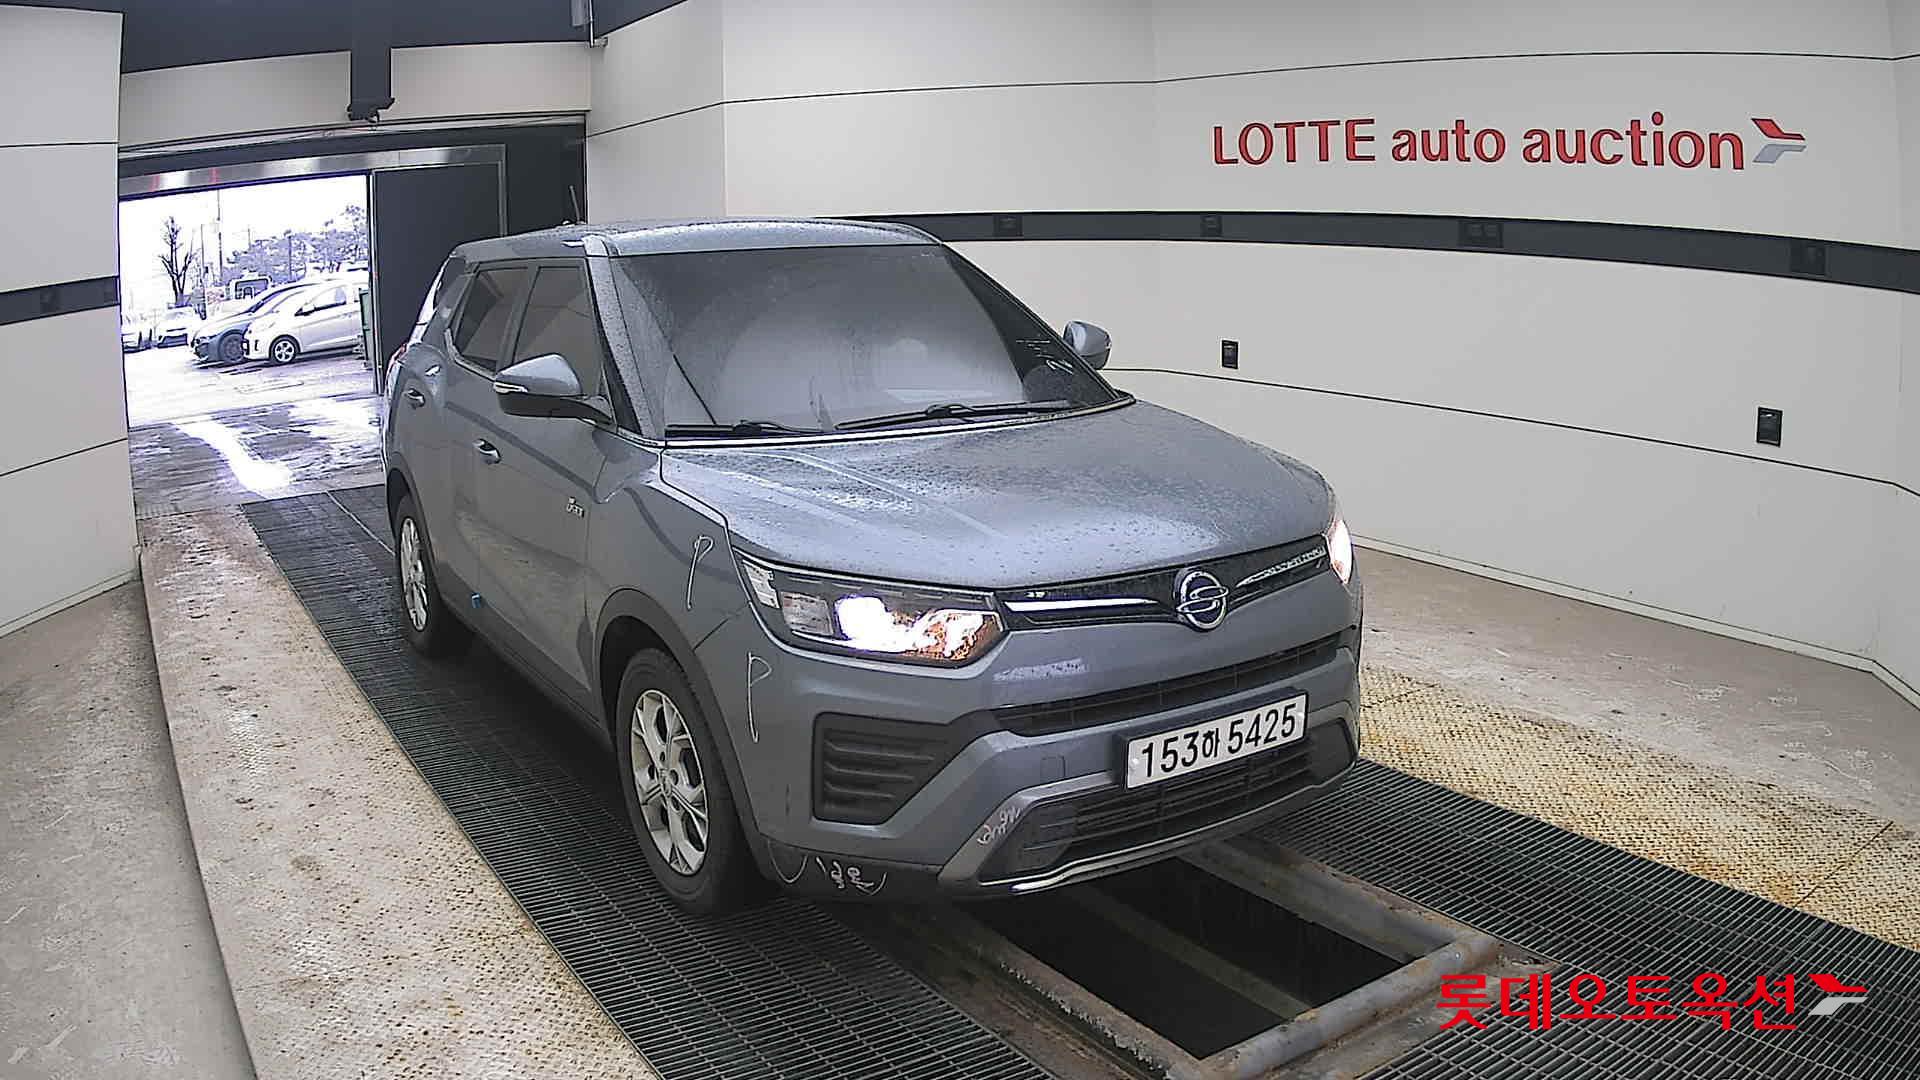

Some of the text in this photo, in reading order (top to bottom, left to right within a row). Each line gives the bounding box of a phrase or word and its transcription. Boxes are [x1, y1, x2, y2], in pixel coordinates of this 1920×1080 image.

[1213, 111, 1745, 171] LOTTE auto auction
[1141, 702, 1297, 778] 153하 5425
